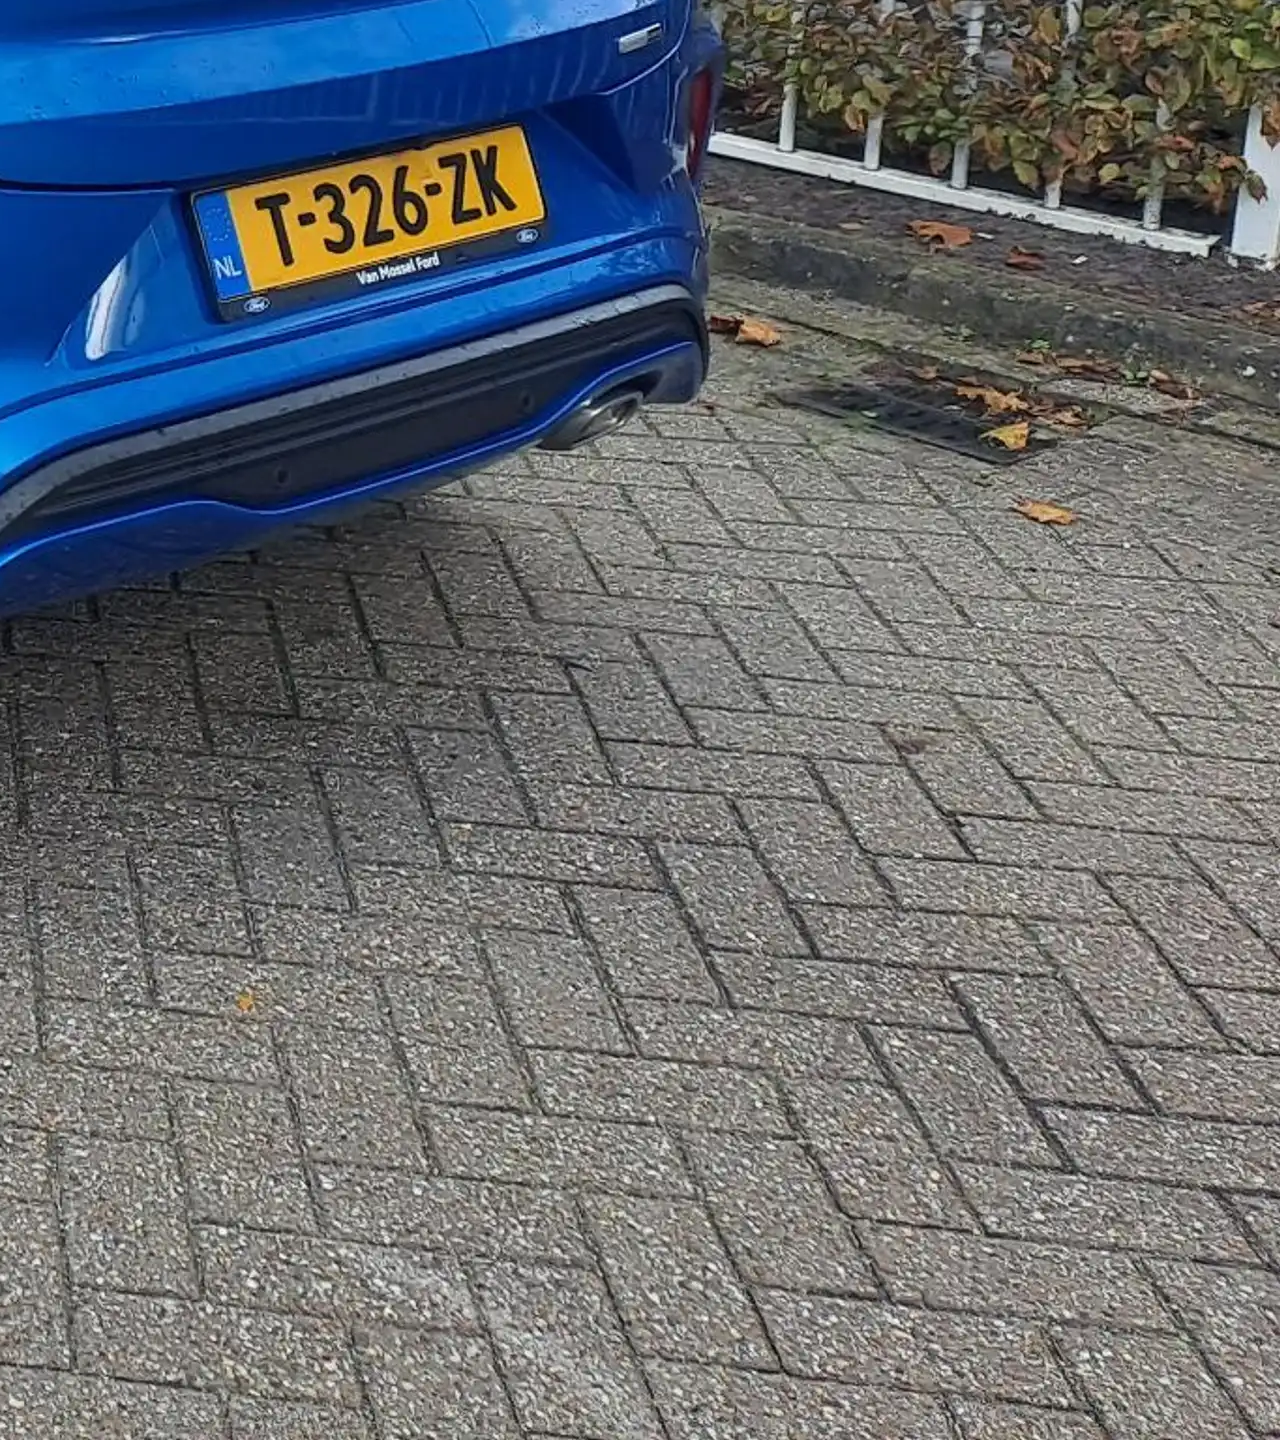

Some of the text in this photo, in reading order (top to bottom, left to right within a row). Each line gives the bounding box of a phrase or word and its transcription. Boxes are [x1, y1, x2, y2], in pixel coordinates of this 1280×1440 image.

[255, 145, 517, 266] T-326-ZK
[213, 255, 242, 280] NL
[356, 251, 440, 285] Van Mossel Ford
